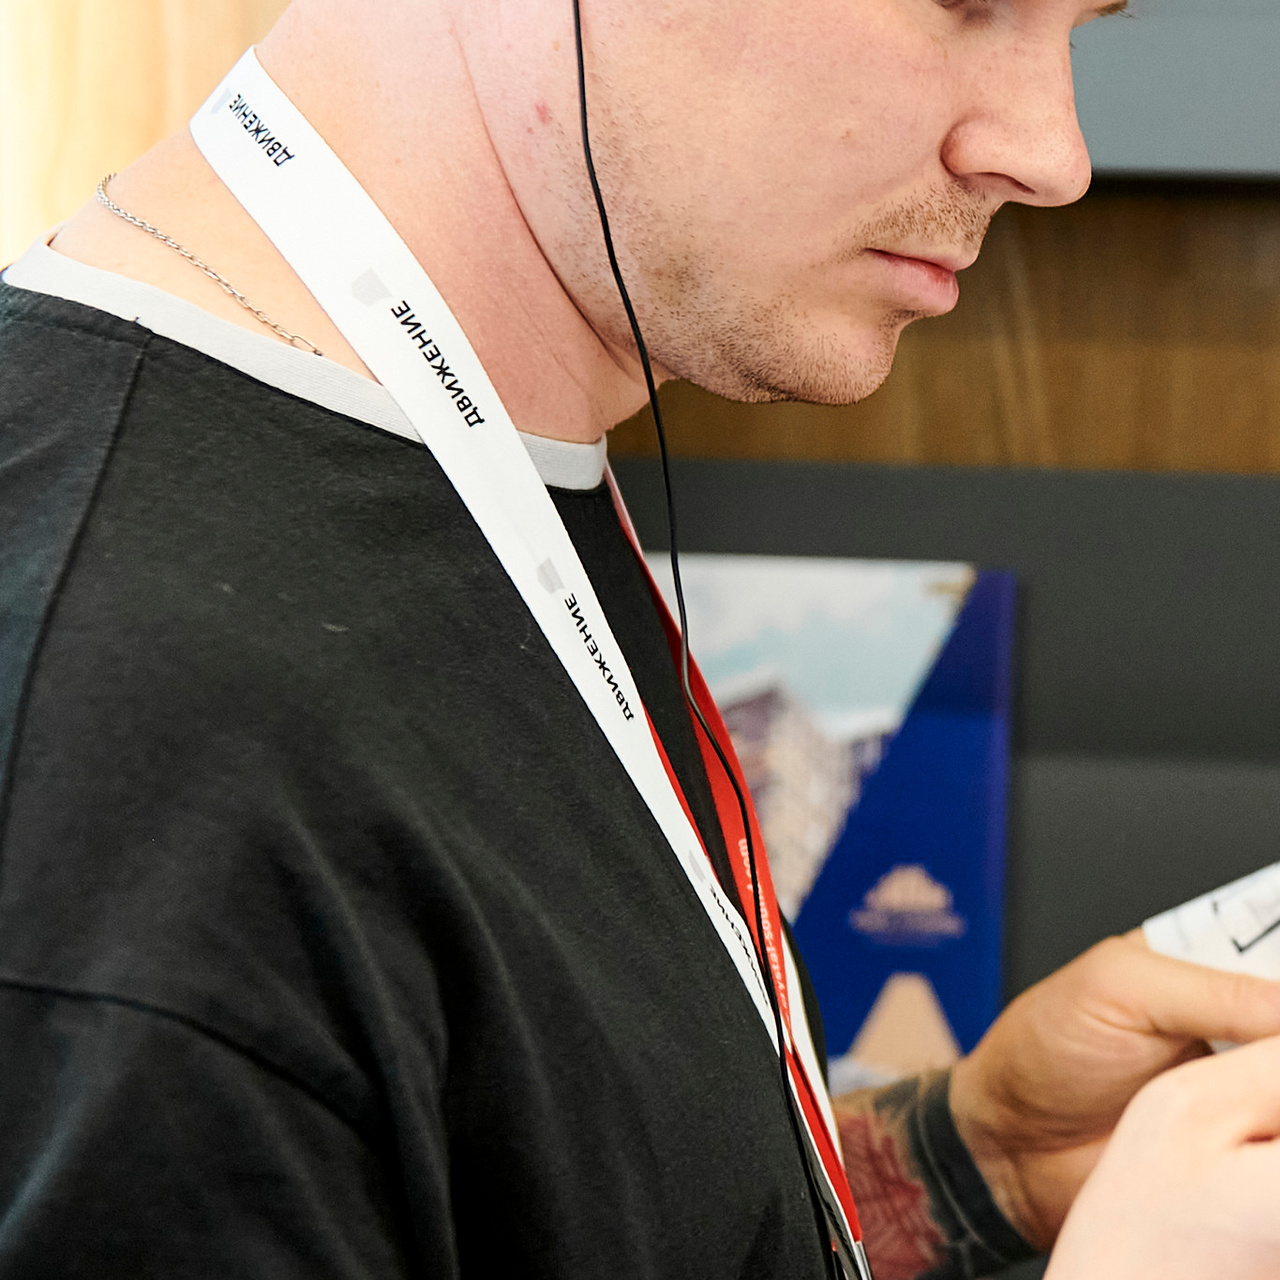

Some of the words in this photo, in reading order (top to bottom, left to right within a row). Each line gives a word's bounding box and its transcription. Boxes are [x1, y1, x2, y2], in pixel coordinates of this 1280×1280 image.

[229, 93, 295, 167] ДВИЖЕНИЕ
[391, 301, 485, 428] ДВИЖЕНИЕ
[565, 593, 634, 721] ДВИЖЕНИЕ
